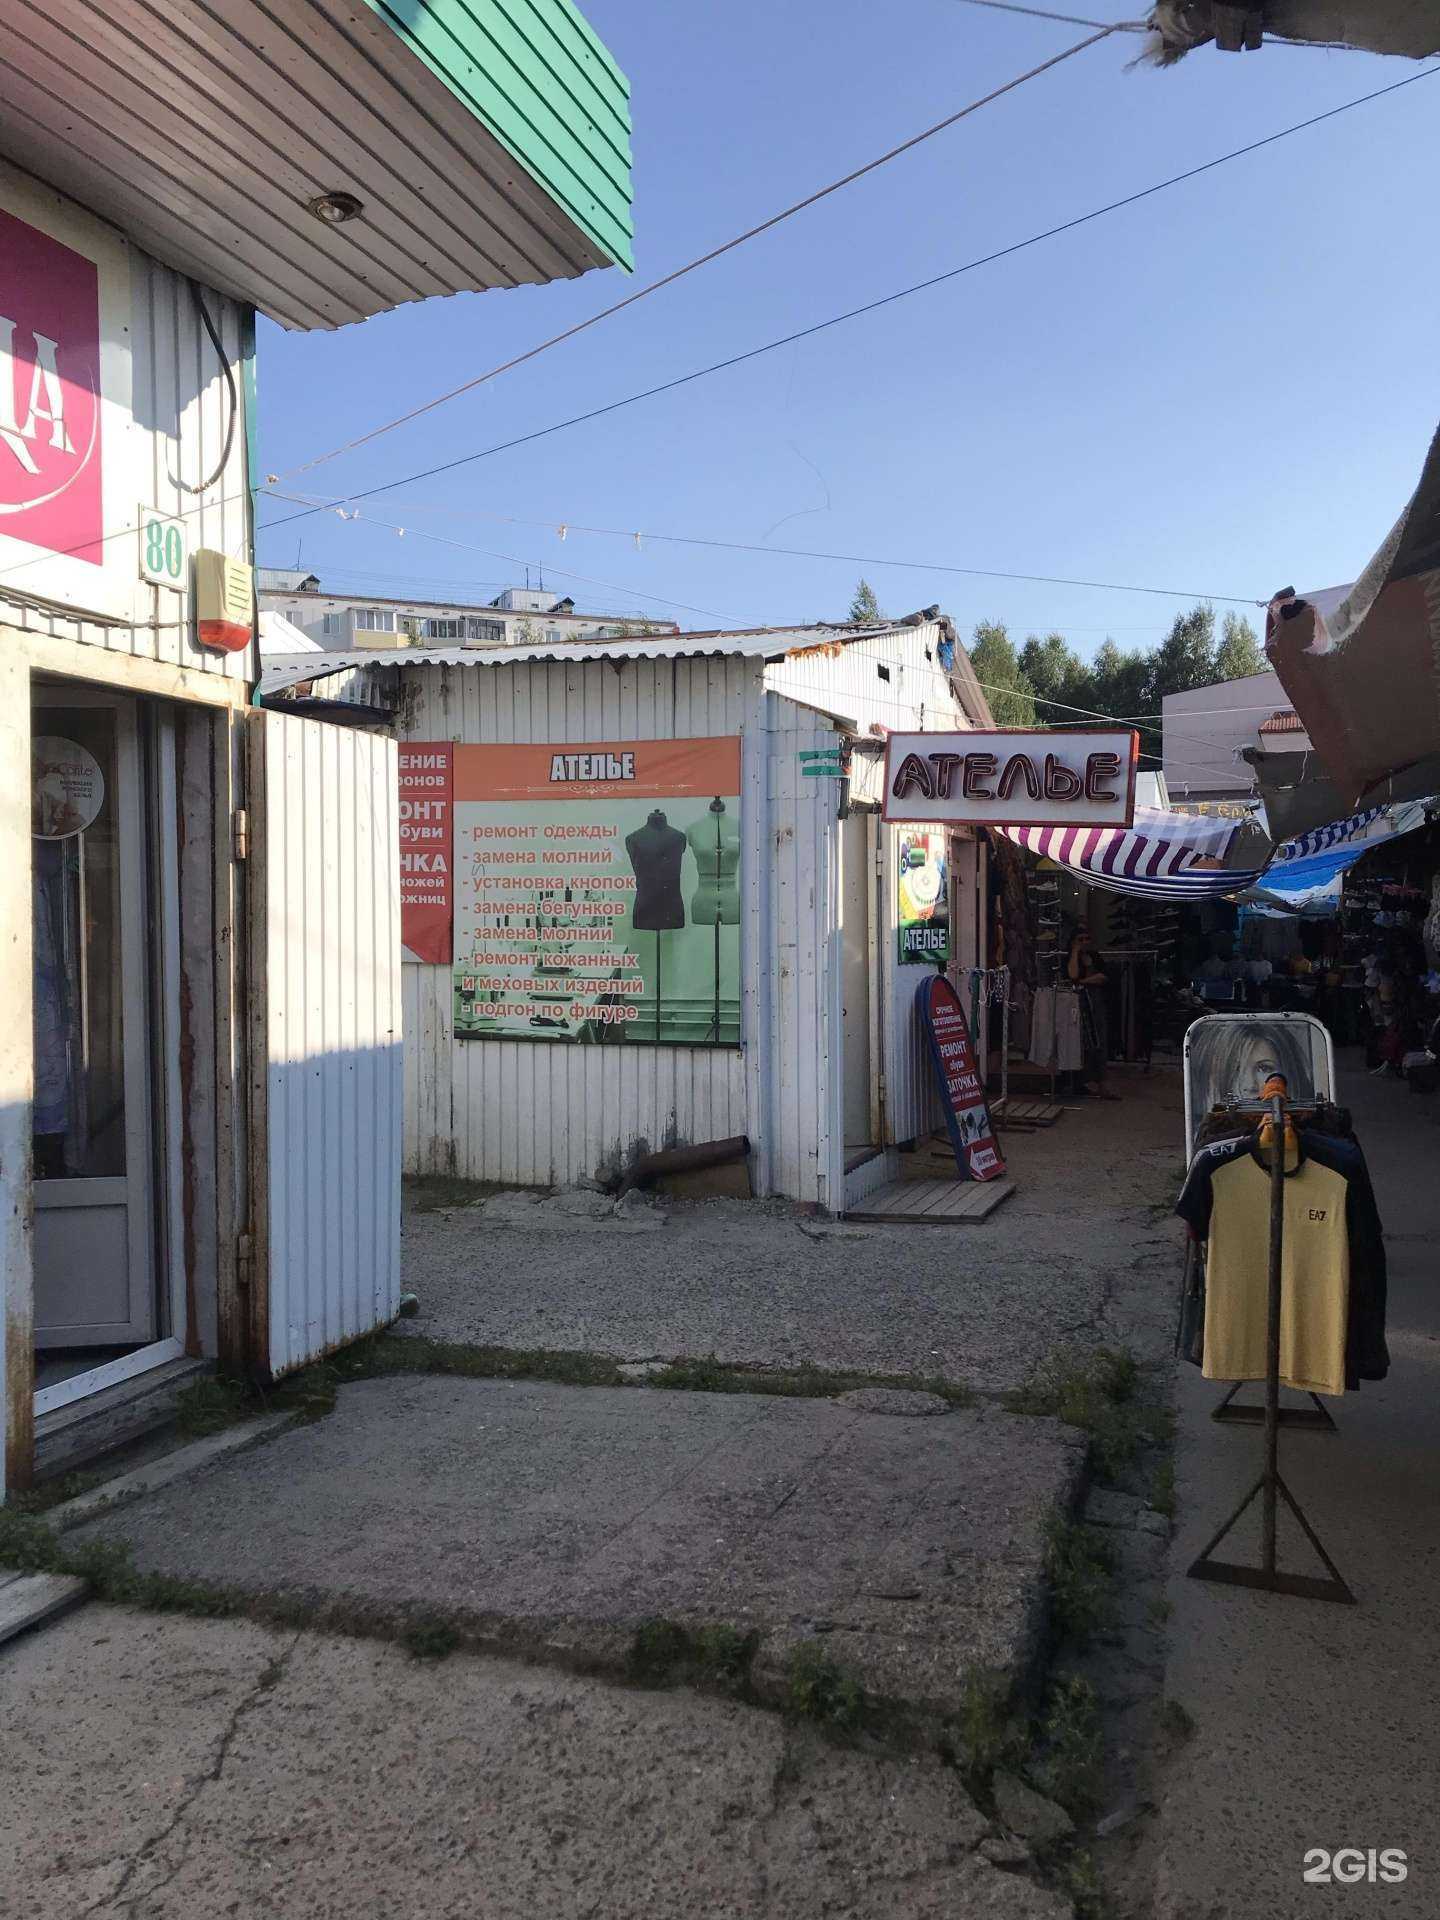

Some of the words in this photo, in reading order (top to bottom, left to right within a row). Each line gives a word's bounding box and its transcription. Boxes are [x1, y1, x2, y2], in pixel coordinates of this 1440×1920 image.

[146, 518, 182, 579] 80
[549, 751, 636, 782] АТЕЛЬЕ
[892, 752, 1121, 803] АТЕЛЬЕ
[399, 800, 447, 820] ОНТ
[400, 823, 443, 842] буви
[473, 825, 538, 842] ремонт
[543, 825, 617, 840] одежды
[473, 850, 536, 864] замена
[542, 848, 612, 864] молний
[473, 877, 564, 892] установка
[570, 877, 636, 889] кнопок
[473, 902, 536, 915] замена
[542, 899, 624, 918] бегунков
[473, 927, 537, 940] замена
[903, 928, 946, 950] АТЕЛЬЕ
[474, 953, 537, 968] ремонт
[544, 954, 637, 967] кожанных
[463, 978, 473, 989] и
[479, 978, 560, 991] меховых
[565, 977, 643, 994] изделий
[474, 1003, 536, 1017] подгон
[542, 1004, 564, 1016] по
[569, 1003, 638, 1023] фигуре
[940, 1040, 967, 1058] РЕМОНТ
[1210, 1142, 1237, 1157] EA7
[1308, 1209, 1327, 1221] EA7
